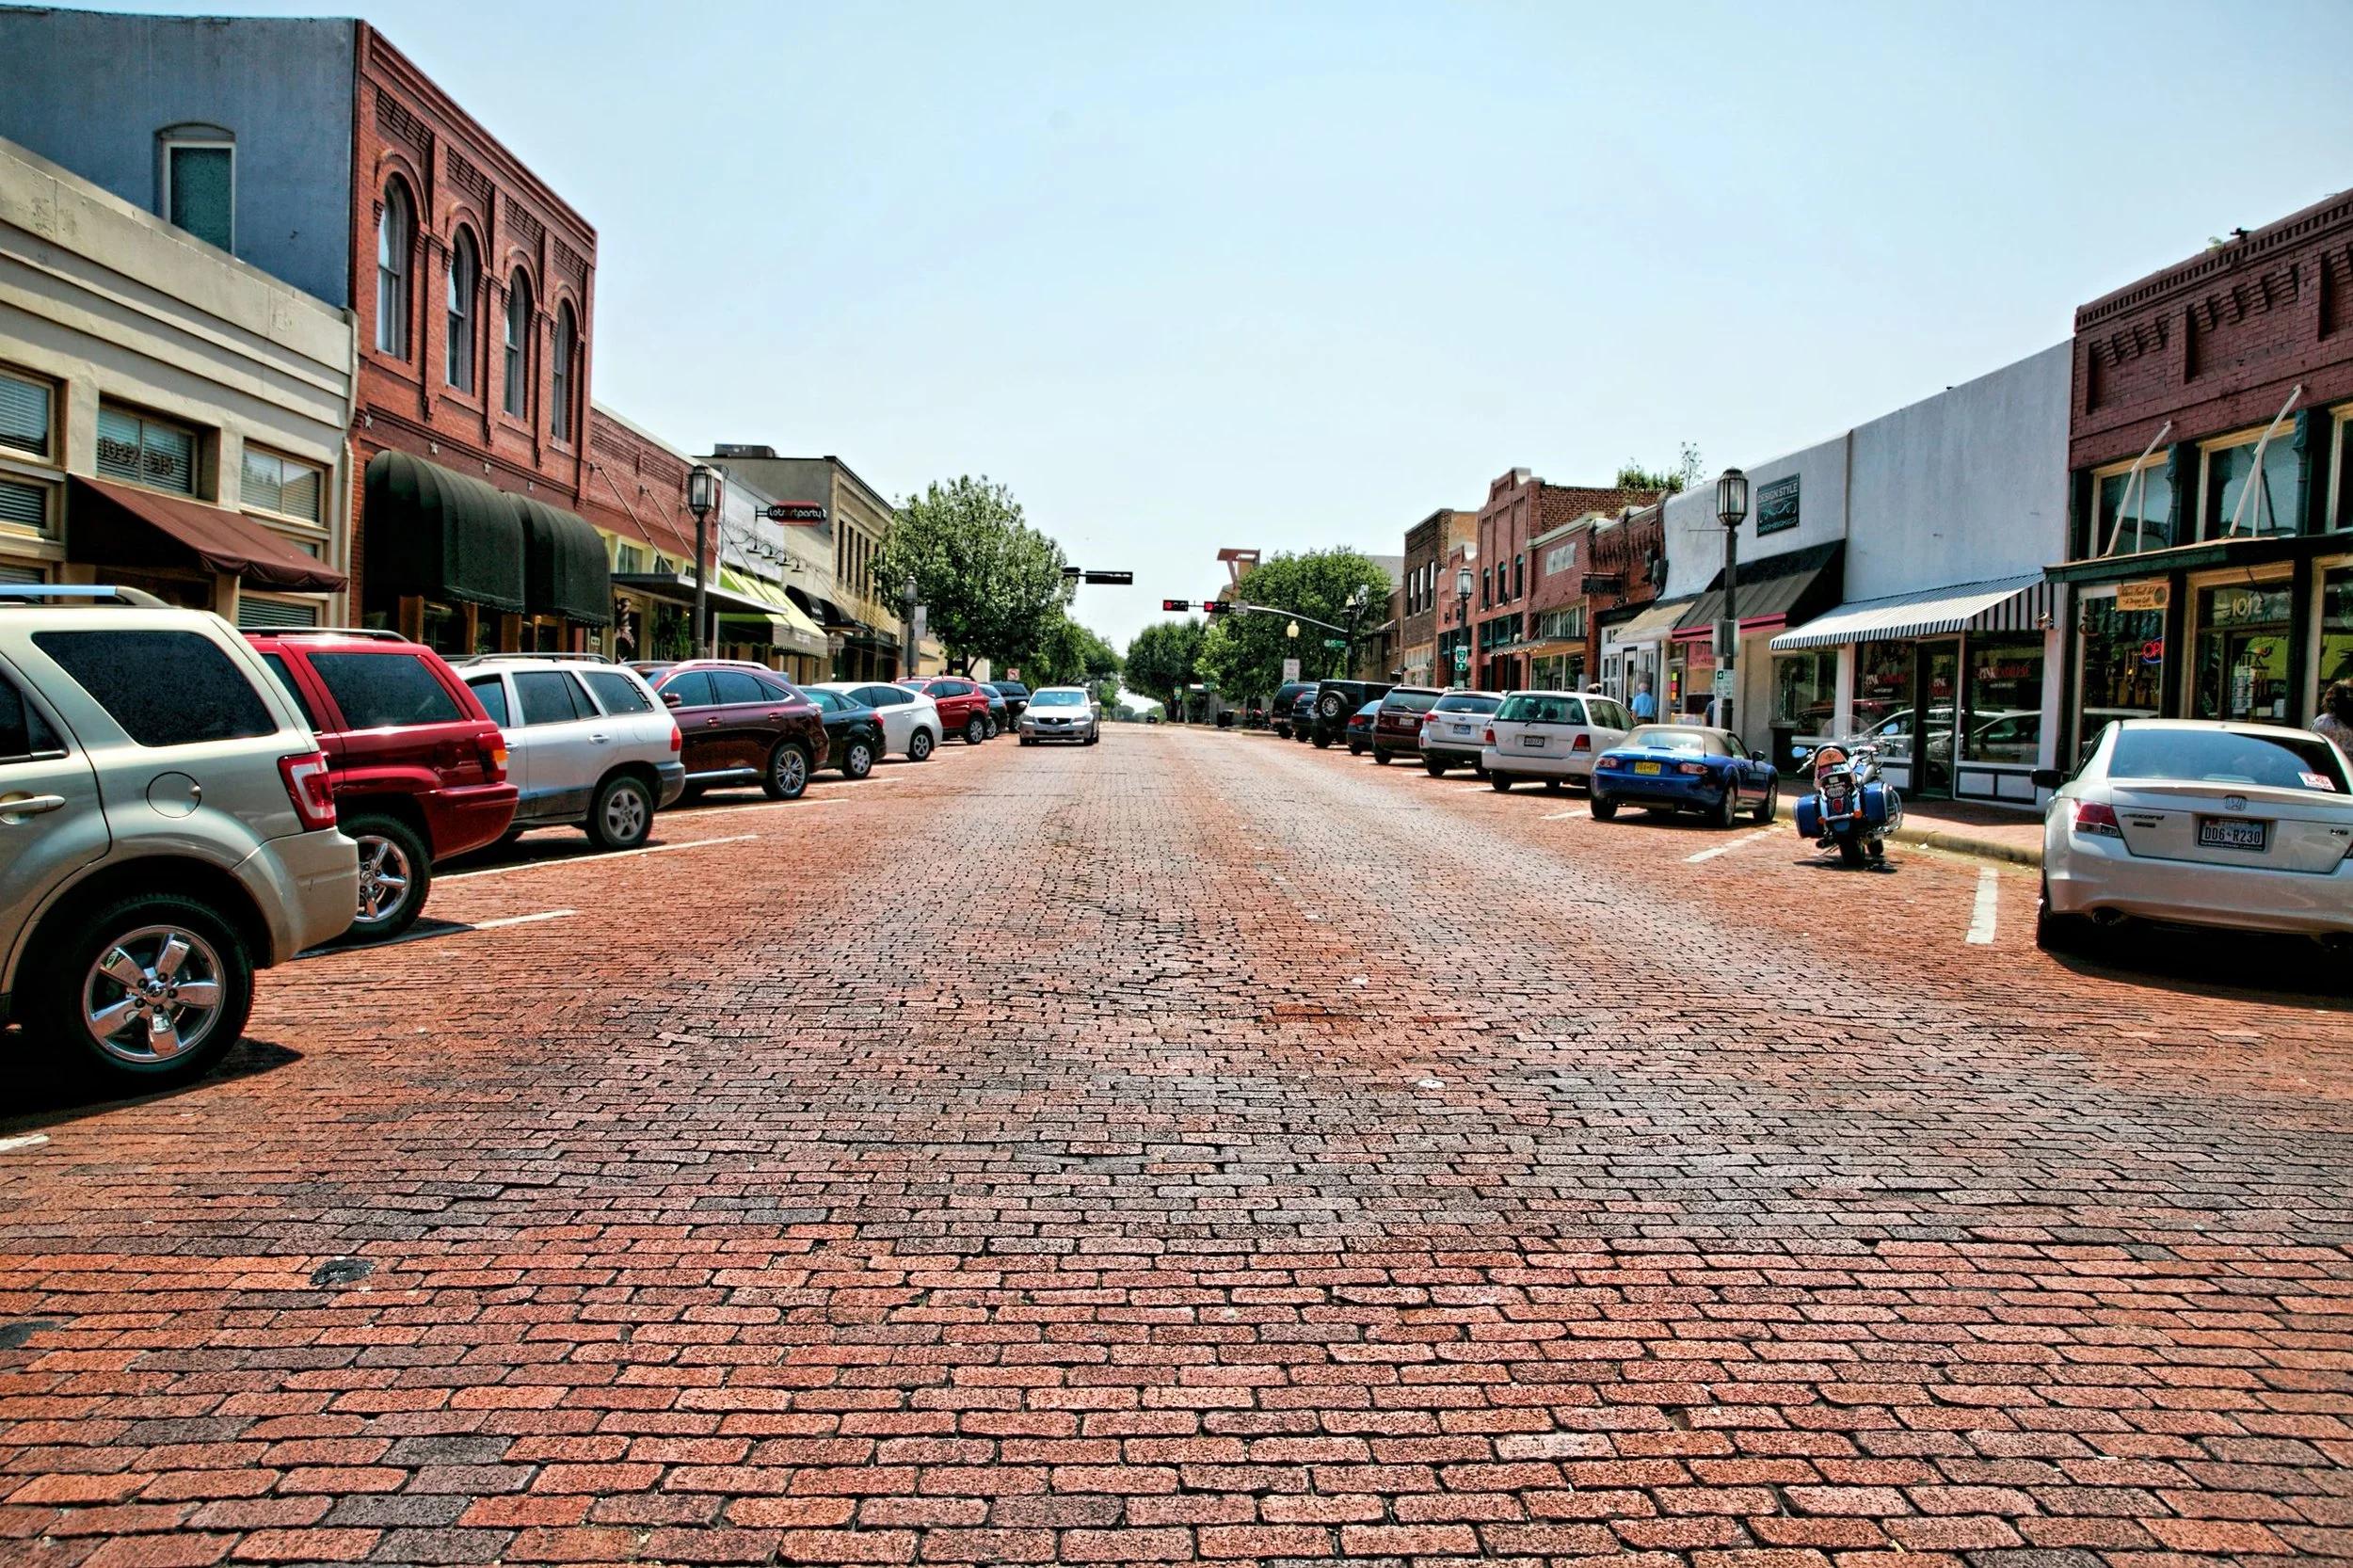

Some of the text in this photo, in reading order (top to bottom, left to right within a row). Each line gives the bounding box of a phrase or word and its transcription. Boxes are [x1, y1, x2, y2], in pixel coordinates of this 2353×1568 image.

[1758, 482, 1798, 504] DESIGN STYLE
[2232, 592, 2264, 617] 1012
